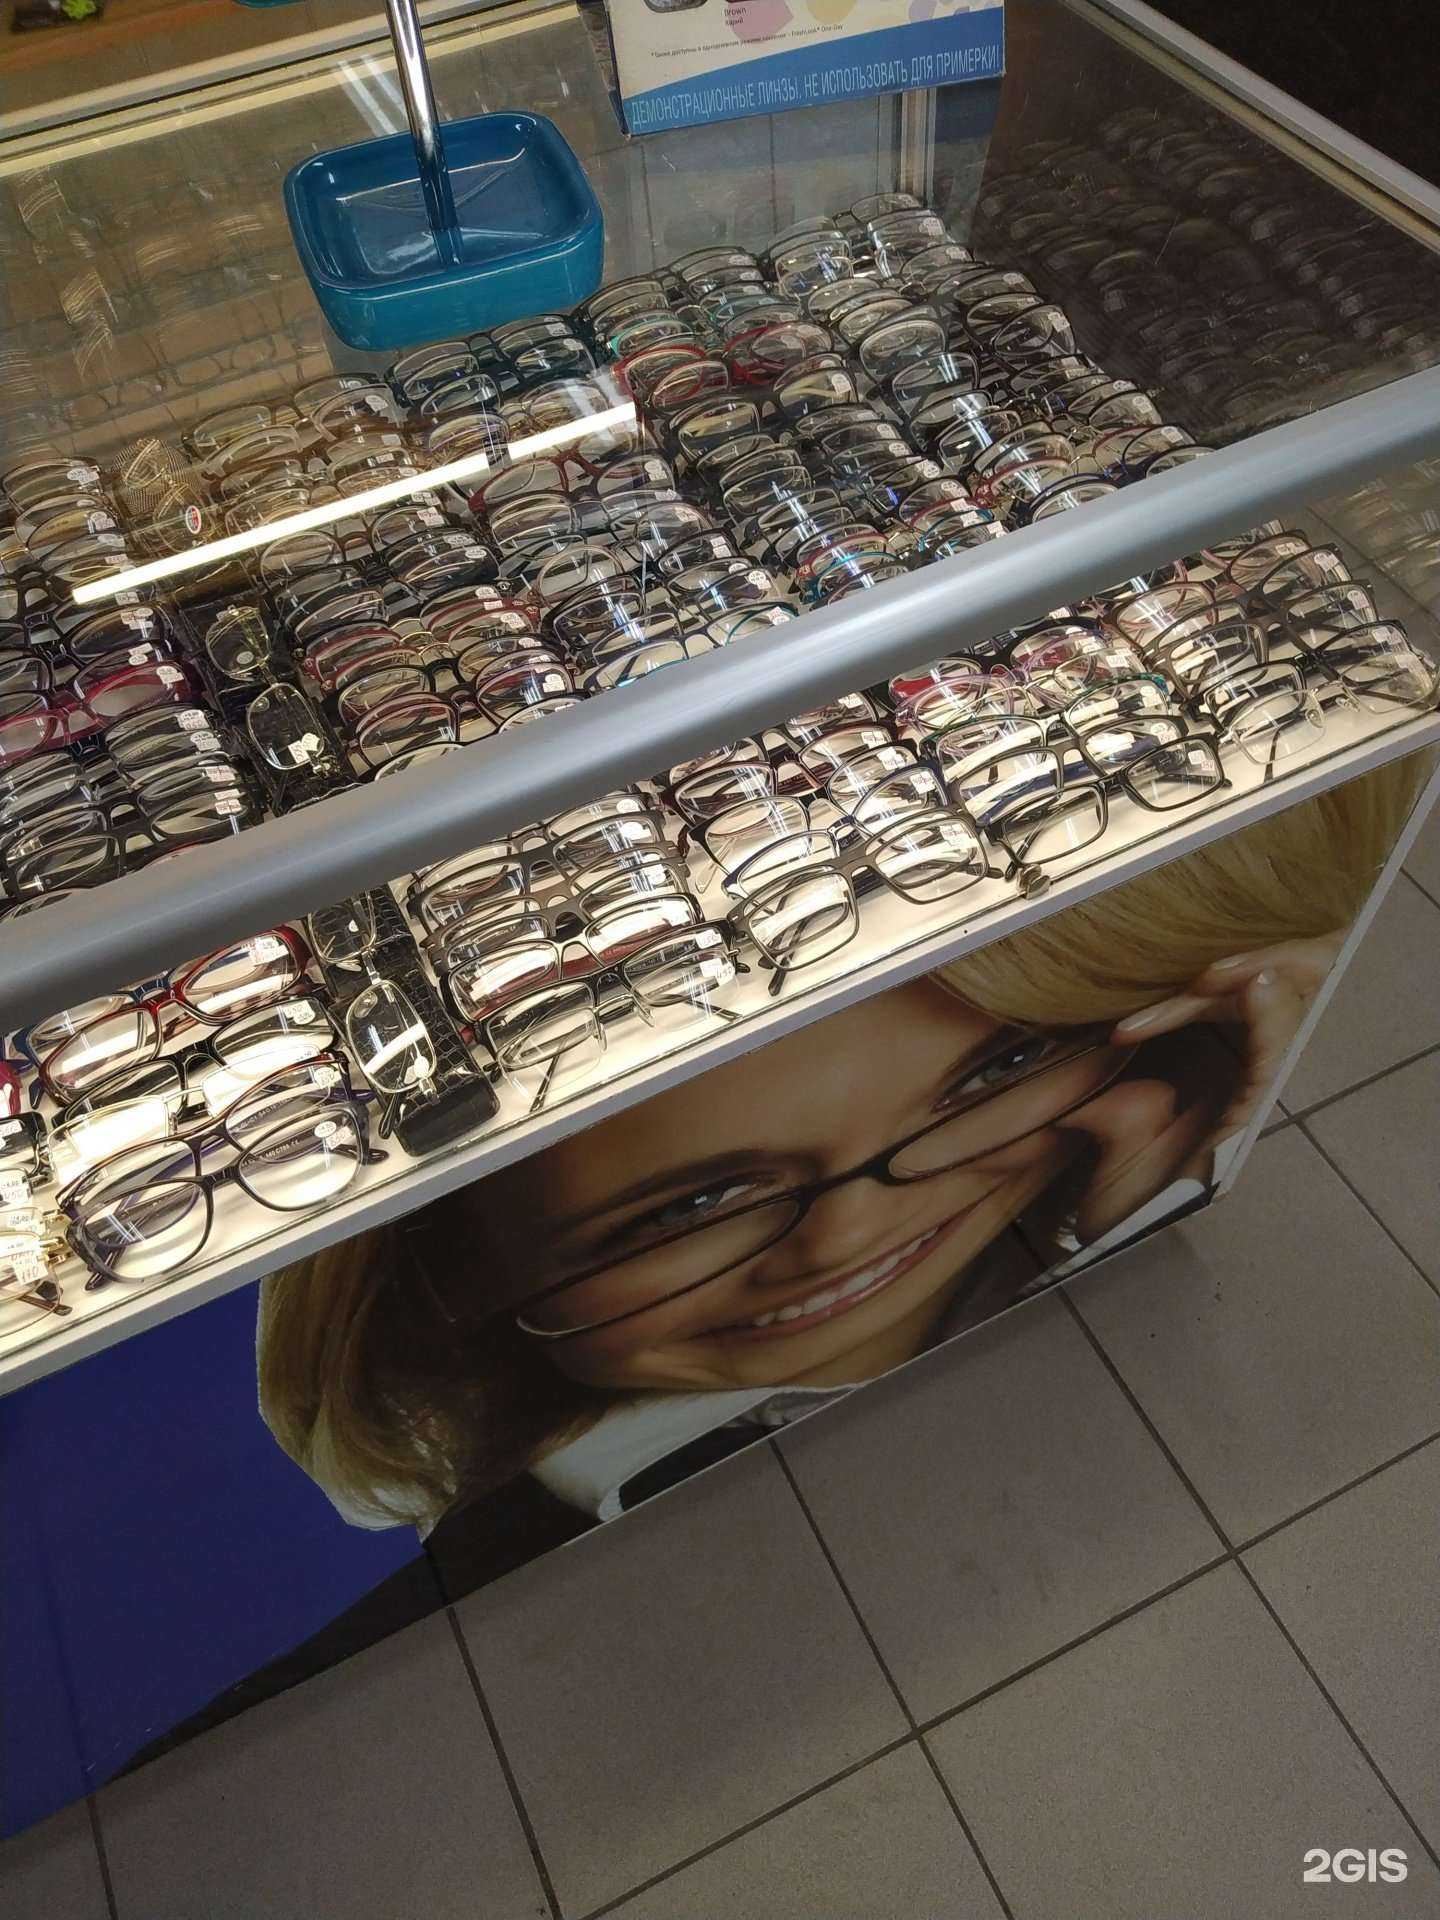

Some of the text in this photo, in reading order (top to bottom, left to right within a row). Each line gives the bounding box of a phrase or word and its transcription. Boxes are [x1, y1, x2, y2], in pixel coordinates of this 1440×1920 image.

[631, 83, 754, 127] ДЕМОНСТРАЦИОННЫЕ
[804, 73, 819, 99] НЕ
[821, 60, 908, 94] ИСПОЛЬЗОВАТЬ
[910, 53, 934, 84] ДЛЯ
[936, 44, 1000, 77] ПРИМЕРКИ!
